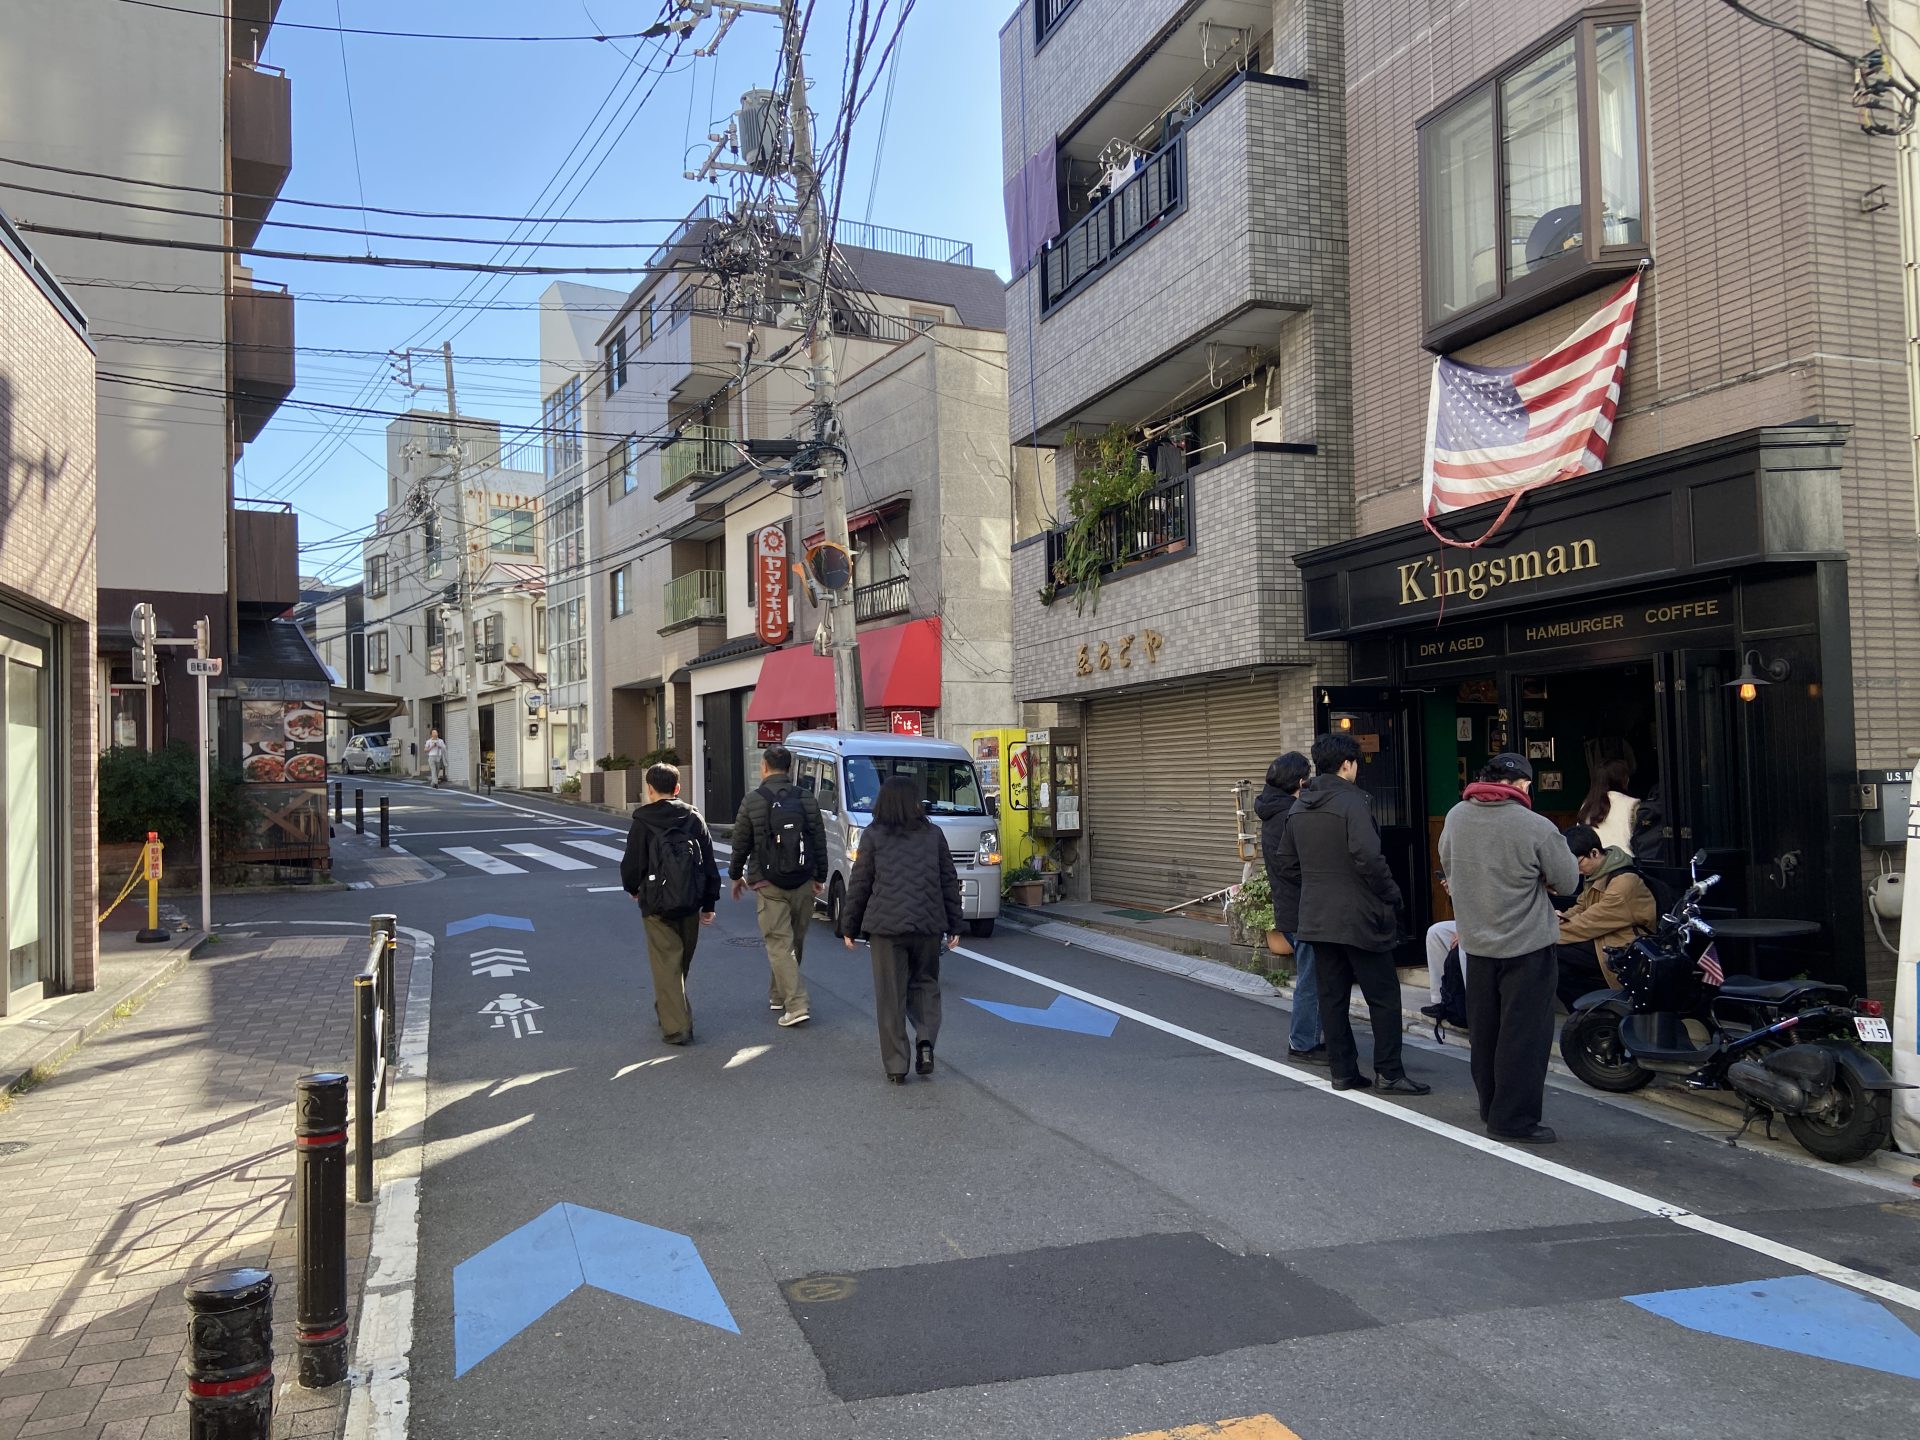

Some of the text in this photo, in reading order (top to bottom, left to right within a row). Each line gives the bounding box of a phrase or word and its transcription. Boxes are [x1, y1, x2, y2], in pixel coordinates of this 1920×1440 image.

[765, 556, 783, 638] ヤマザキパン
[1526, 599, 1719, 641] HAMBURGER COFFEE
[1420, 636, 1485, 657] DRY AGED
[759, 723, 781, 741] たばこ
[894, 713, 920, 734] たばこ
[1886, 771, 1903, 782] U.S.
